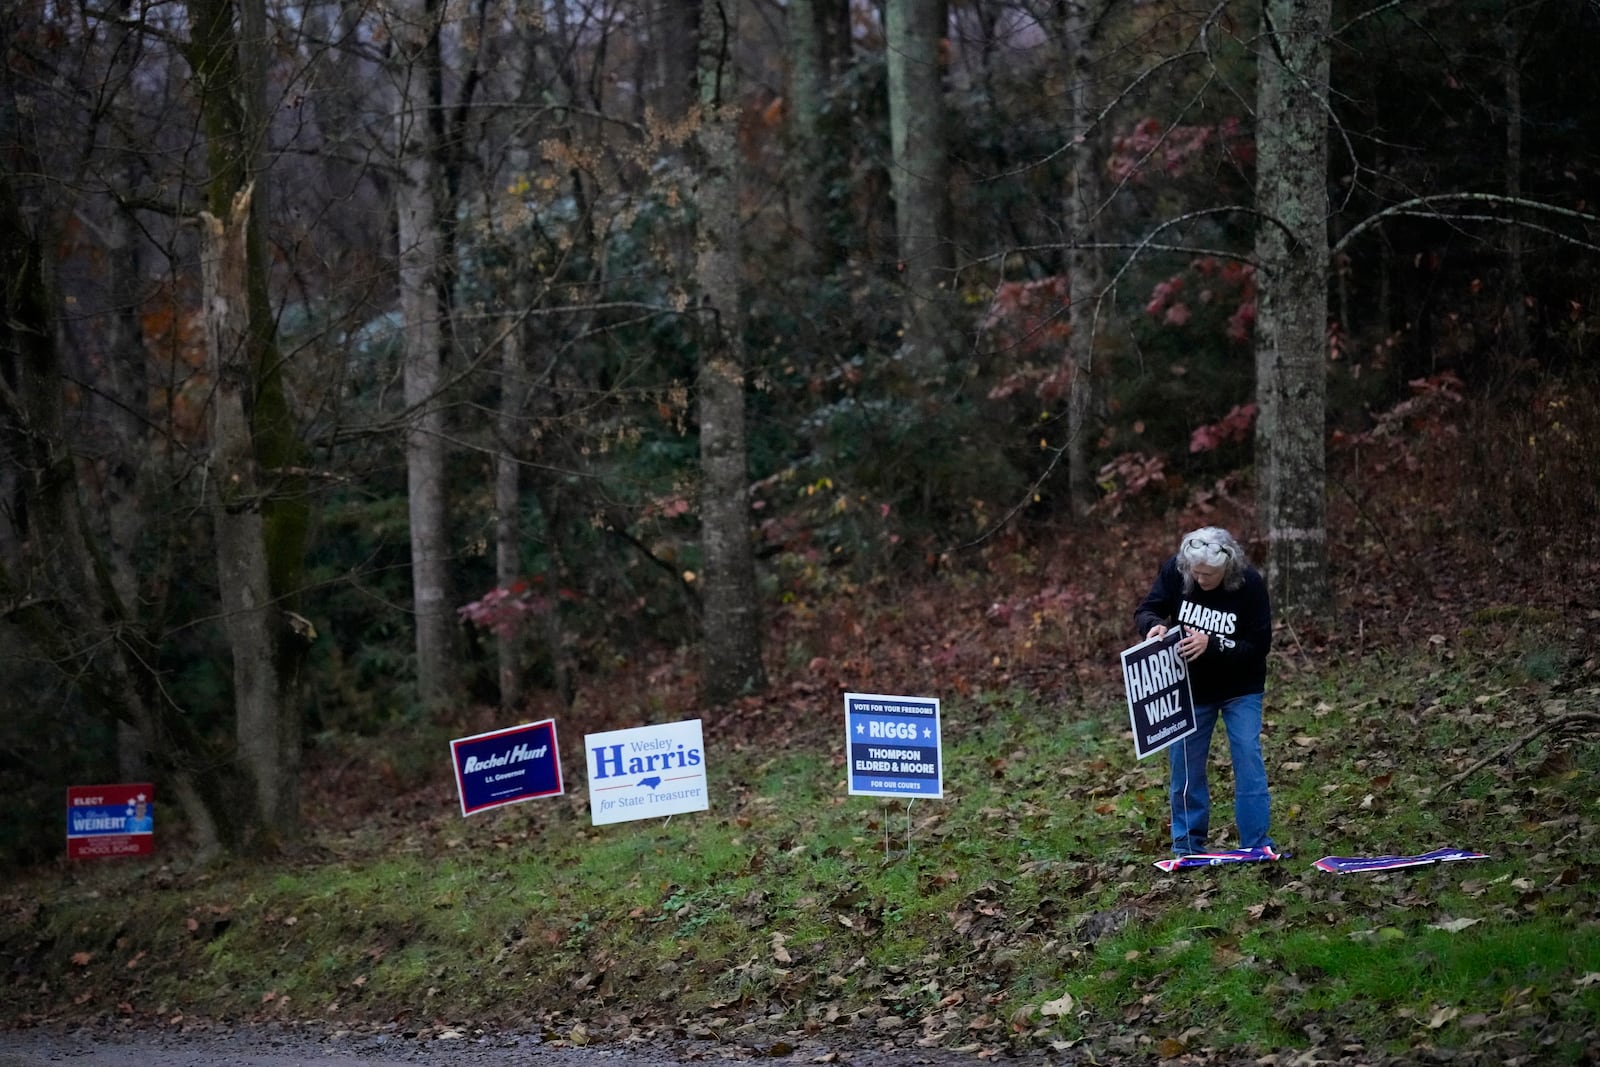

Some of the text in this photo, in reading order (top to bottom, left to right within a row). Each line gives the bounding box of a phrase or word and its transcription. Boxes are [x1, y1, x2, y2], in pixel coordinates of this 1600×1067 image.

[1178, 599, 1238, 635] HARRIS
[1127, 642, 1186, 704] HARRIS
[854, 703, 933, 715] VOTE FOR YOUR FREEDOMS
[1144, 688, 1183, 726] WALZ
[869, 720, 917, 740] RIGGS
[630, 738, 672, 753] Wesley
[463, 743, 548, 775] Rachel Hunt
[591, 743, 701, 779] Harris
[868, 748, 920, 760] THOMPSON
[856, 760, 935, 774] ELDRED & MOORE
[495, 769, 526, 781] Governor
[870, 780, 920, 790] FOR OUR COURTS
[74, 796, 104, 806] ELECT
[600, 788, 701, 813] for State Treasurer
[73, 817, 126, 831] WEINERT
